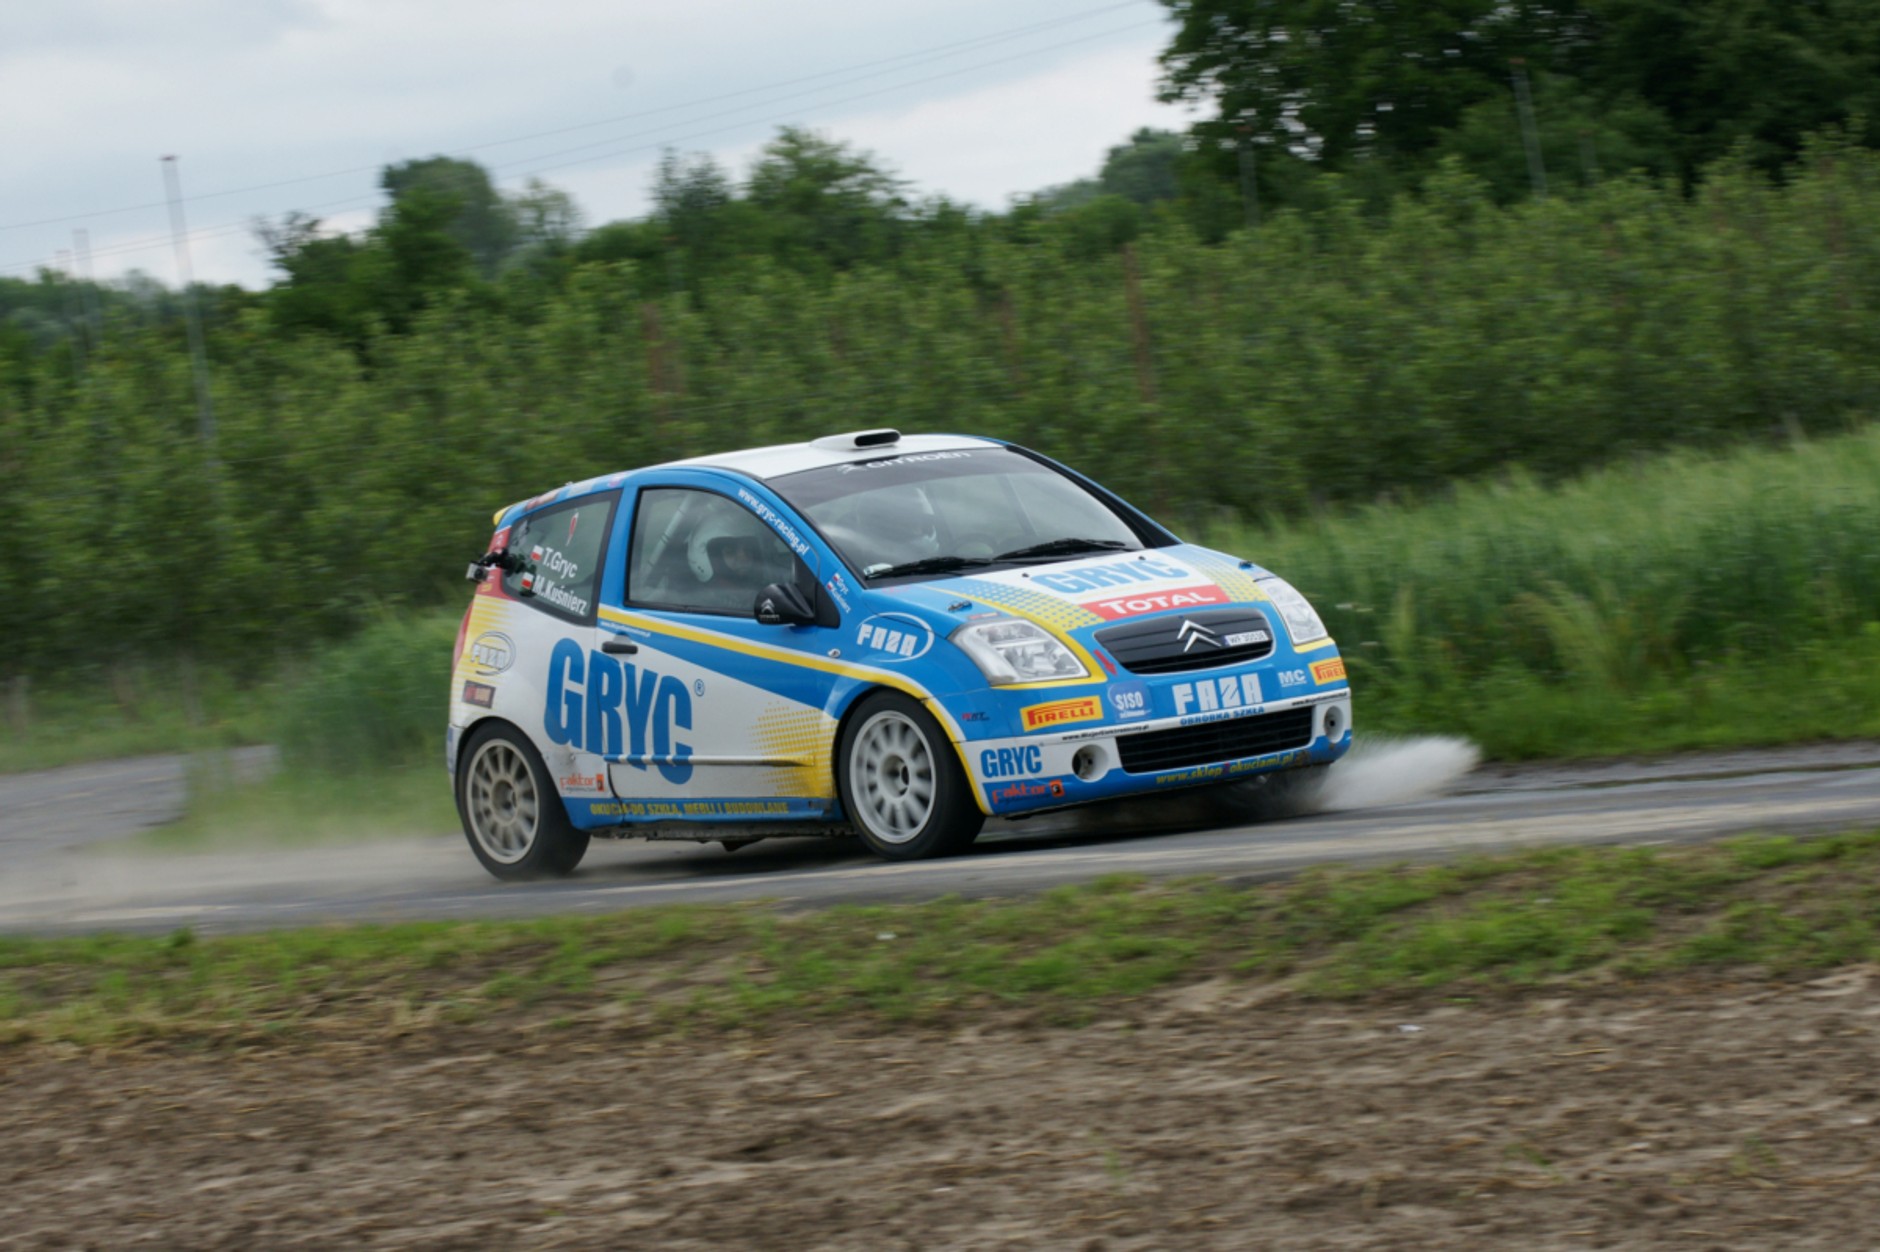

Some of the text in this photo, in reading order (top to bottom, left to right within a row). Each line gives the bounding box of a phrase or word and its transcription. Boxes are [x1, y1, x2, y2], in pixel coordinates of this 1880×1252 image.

[738, 488, 810, 555] www.gryc-racing.pl
[543, 546, 578, 579] T.Gryc
[1030, 560, 1189, 593] GRYC
[1099, 592, 1216, 614] TOTAL
[1278, 669, 1306, 684] MC
[1313, 660, 1346, 680] PIREL
[544, 638, 694, 785] GRYC
[1027, 700, 1095, 726] PIRELLI
[1115, 691, 1143, 711] SISO
[980, 745, 1042, 778] GRYC
